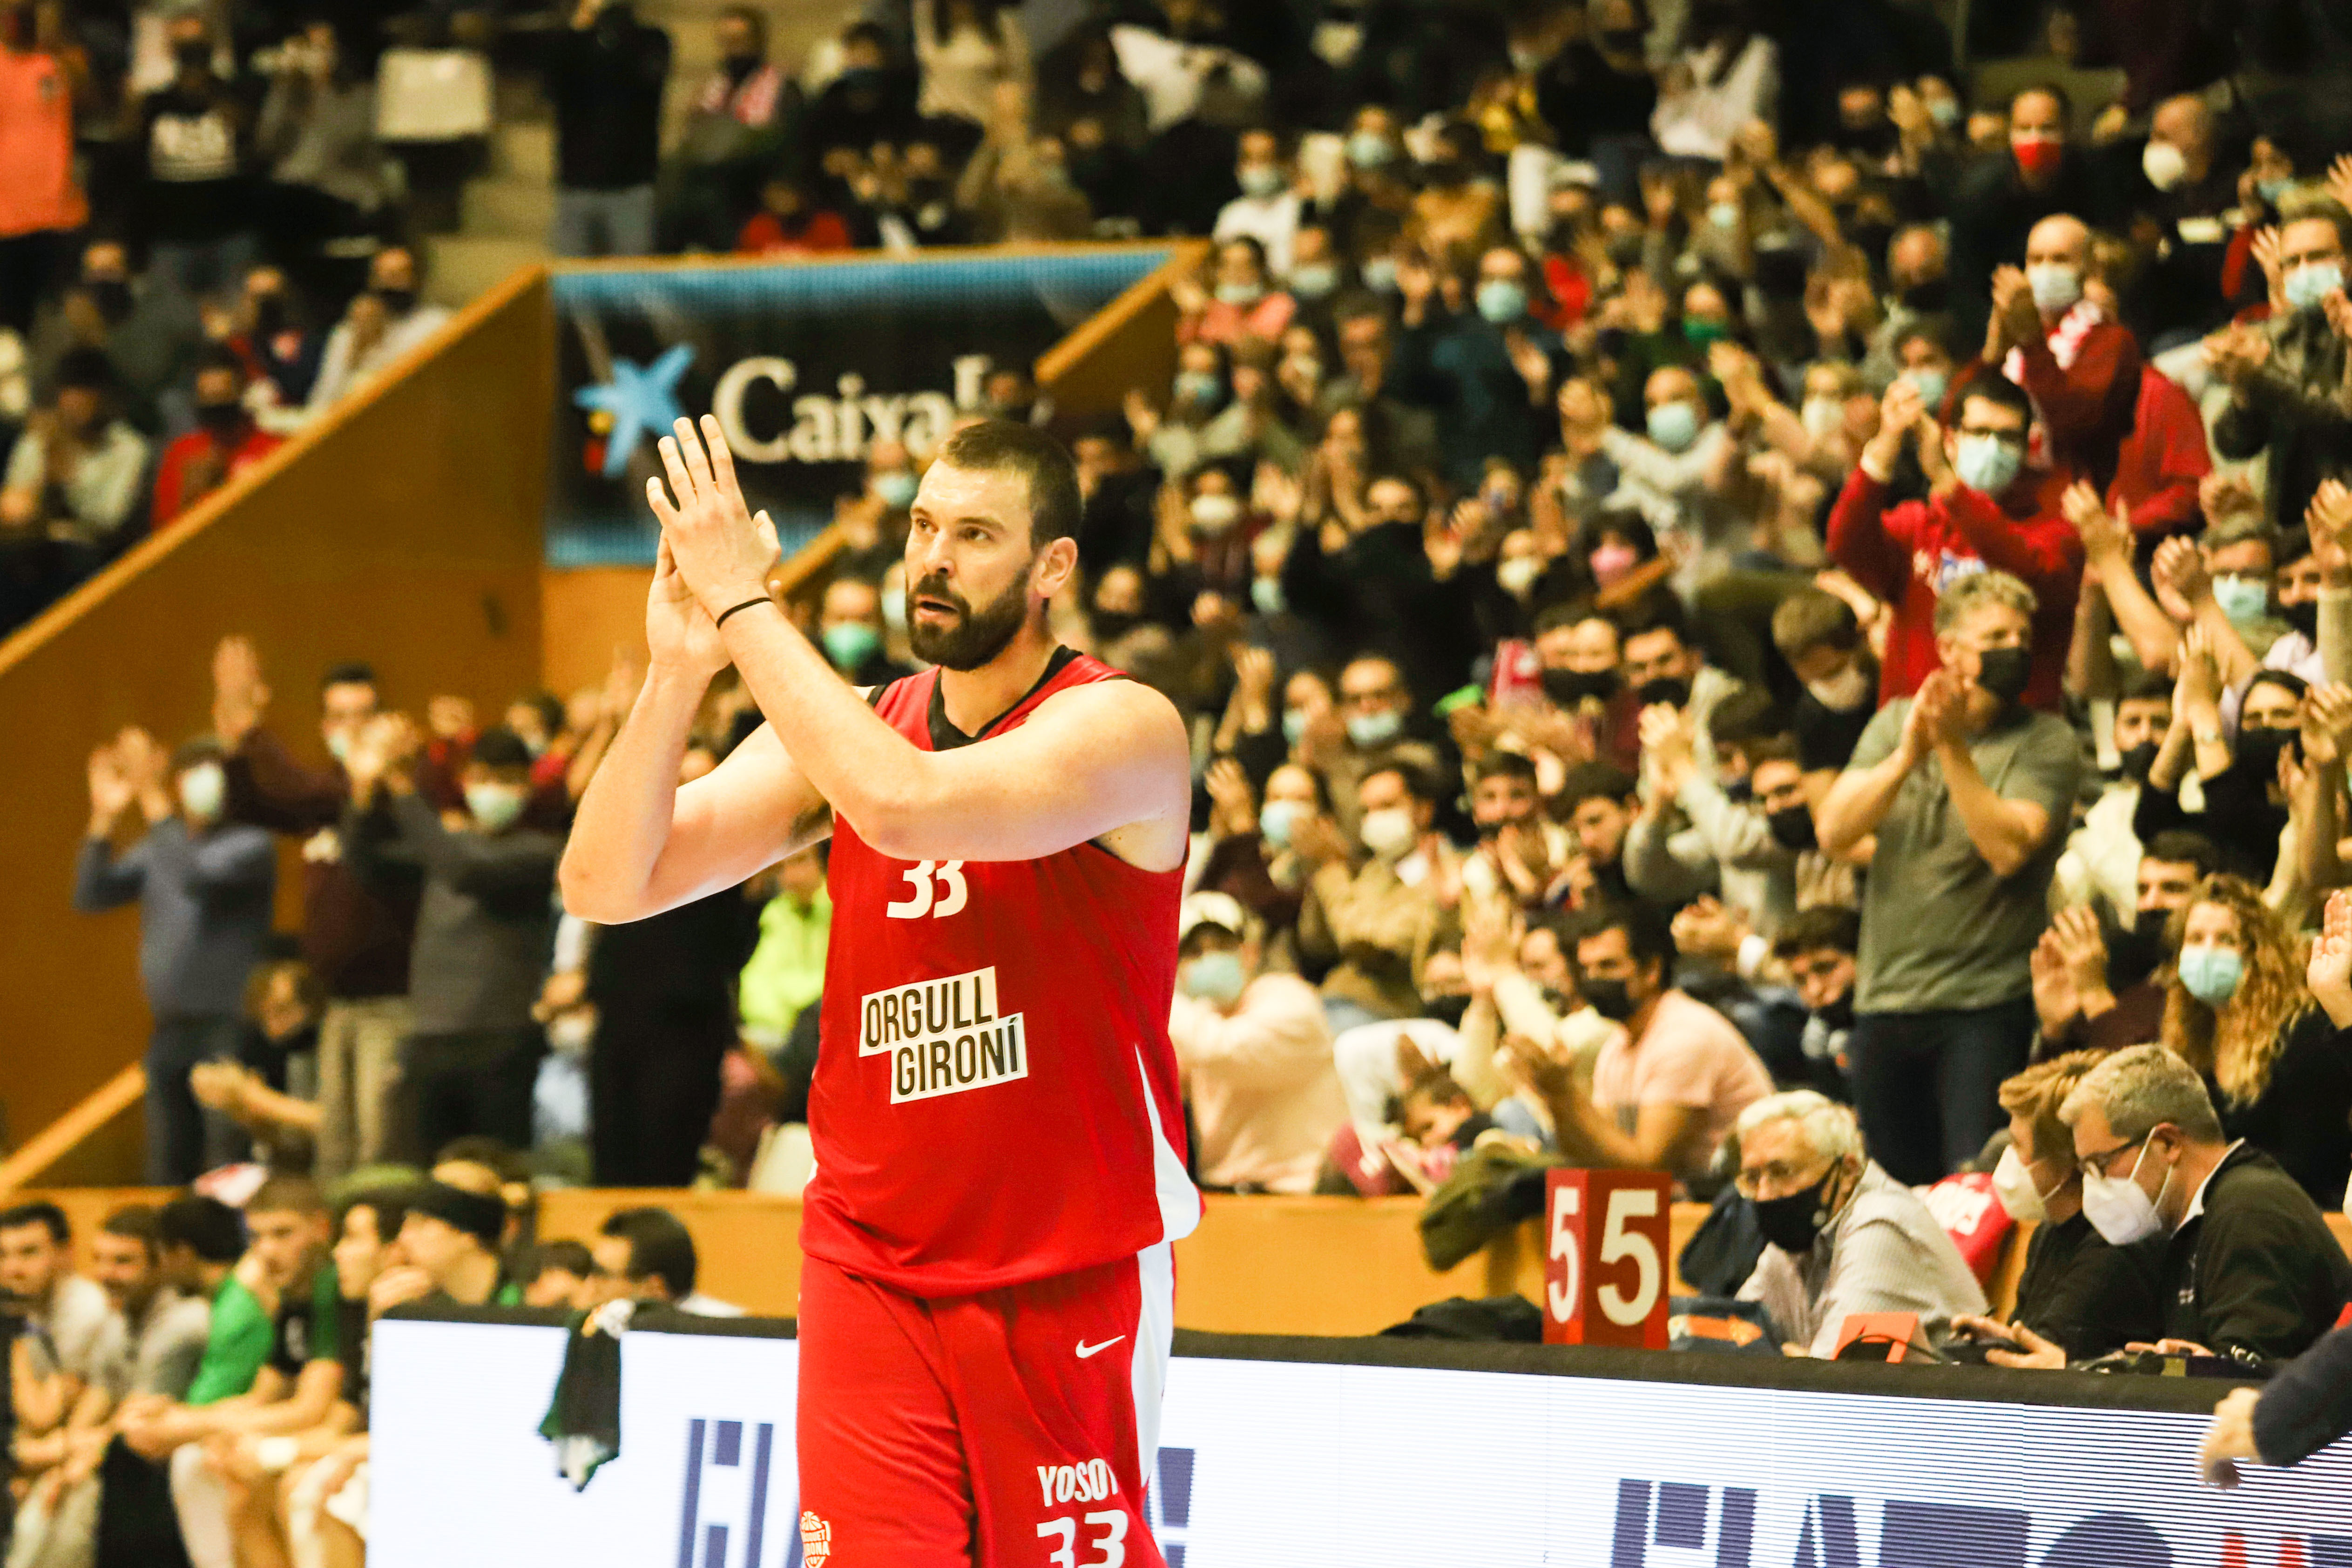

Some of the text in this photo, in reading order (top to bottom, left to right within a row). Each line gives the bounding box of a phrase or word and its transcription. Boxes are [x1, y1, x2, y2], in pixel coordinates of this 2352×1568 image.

[887, 859, 968, 919] 33
[865, 976, 992, 1048] ORGULL
[897, 1016, 1020, 1096] GIRONÍ
[1548, 1187, 1580, 1323] 5
[1597, 1189, 1661, 1326] 5
[1036, 1509, 1129, 1568] 33
